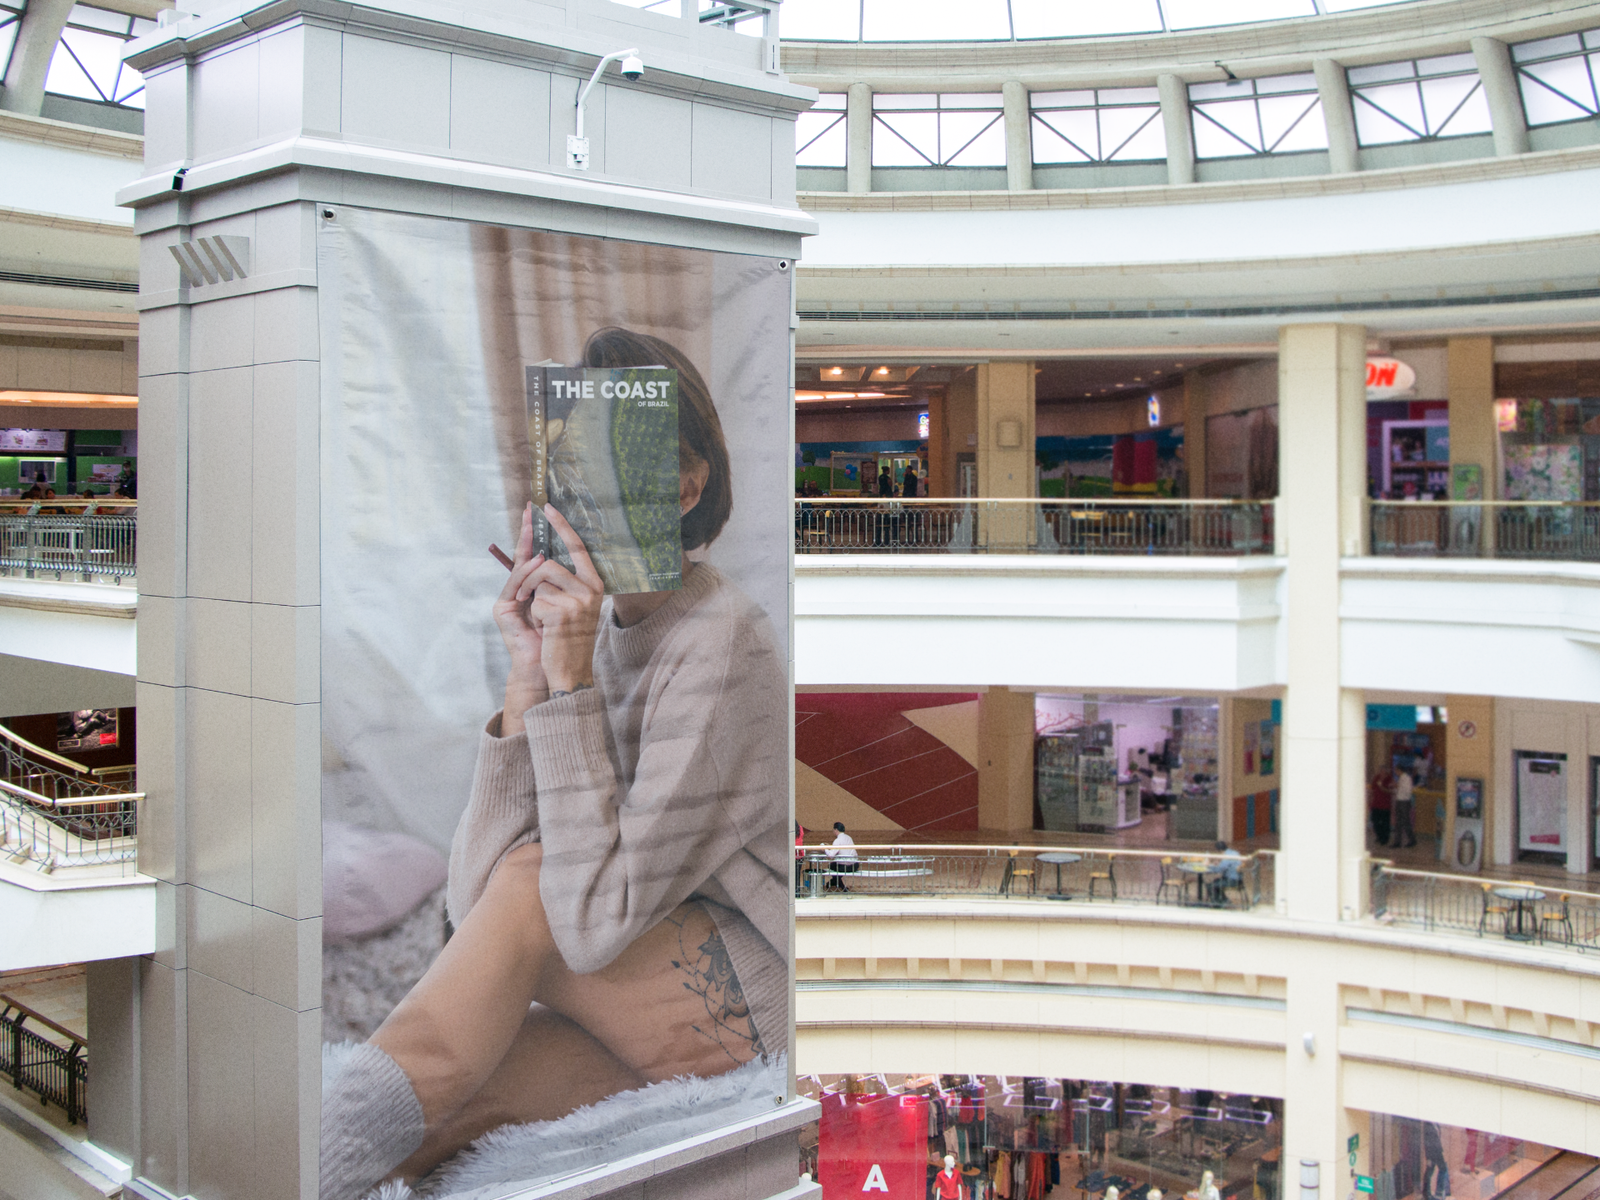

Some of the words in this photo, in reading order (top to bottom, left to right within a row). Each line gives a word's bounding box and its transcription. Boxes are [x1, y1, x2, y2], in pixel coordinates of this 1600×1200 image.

[551, 380, 595, 399] THE
[600, 380, 670, 399] COAST
[637, 400, 647, 408] OF
[647, 400, 670, 408] BRAZIL
[535, 441, 542, 455] OF
[861, 1163, 889, 1193] A
